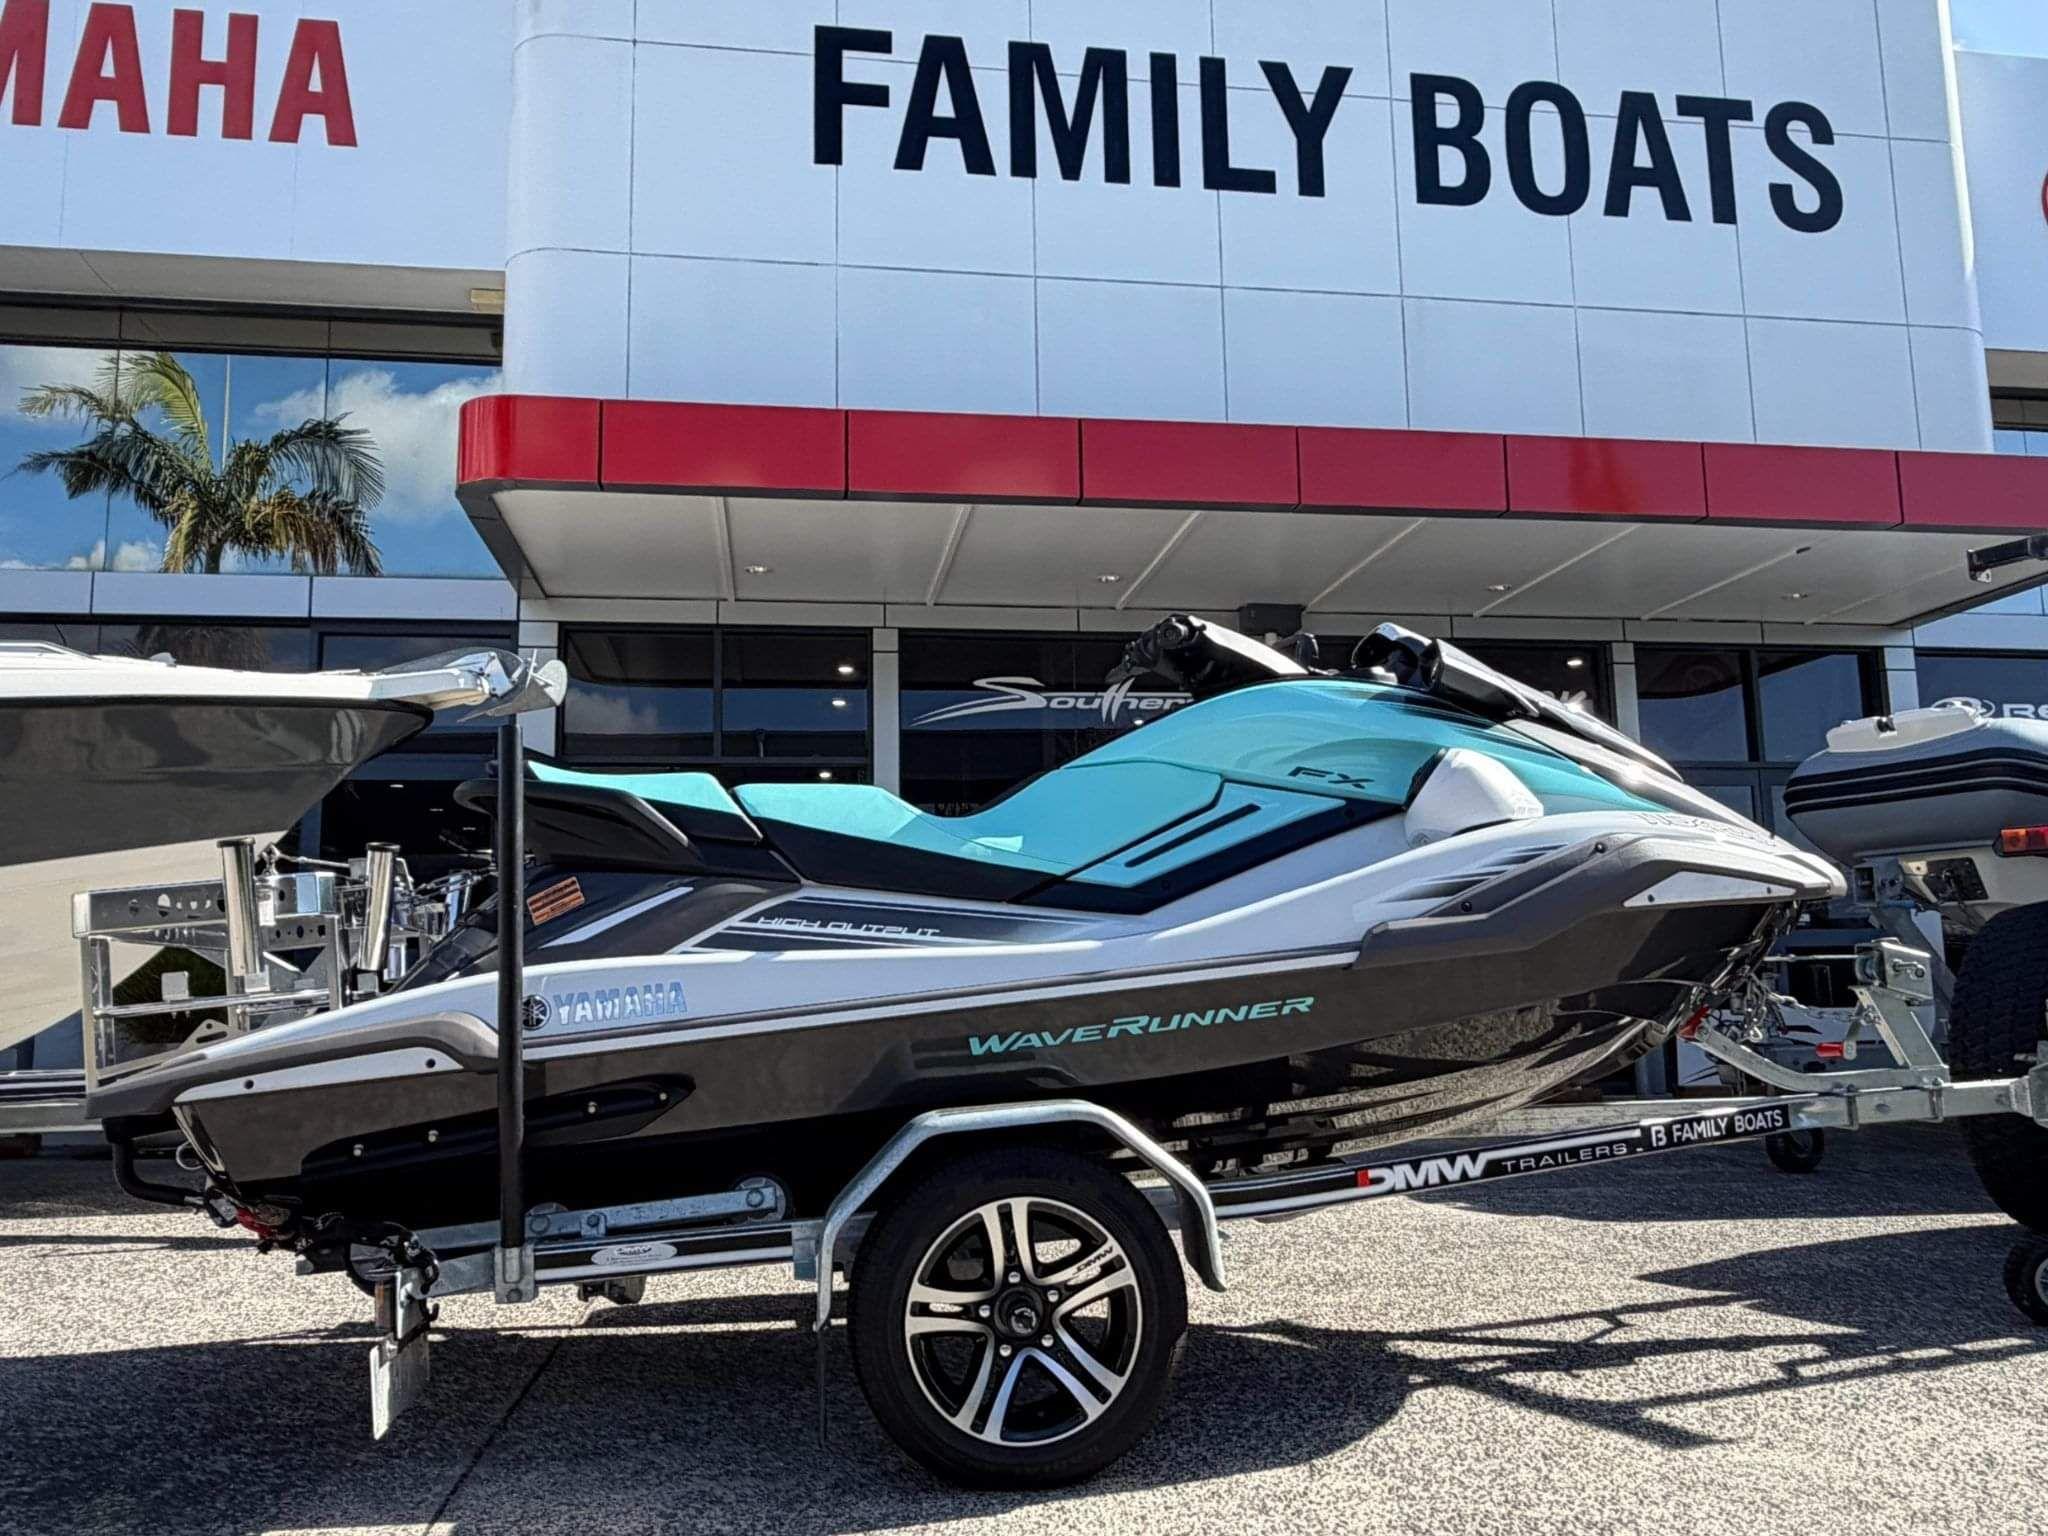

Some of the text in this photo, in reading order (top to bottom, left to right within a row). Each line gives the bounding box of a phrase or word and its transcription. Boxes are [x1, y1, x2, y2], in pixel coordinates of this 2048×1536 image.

[814, 25, 1843, 233] FAMILY BOATS
[908, 676, 1194, 727] Souther
[1288, 766, 1375, 789] FX
[757, 916, 940, 937] HIGH OUTPUT
[552, 981, 688, 1025] YAMAHA
[968, 996, 1315, 1056] WAVERUNNER
[1672, 1117, 1728, 1143] FAMILY
[1734, 1109, 1783, 1133] BOATS
[1356, 1143, 1628, 1191] DMW TRAILERS
